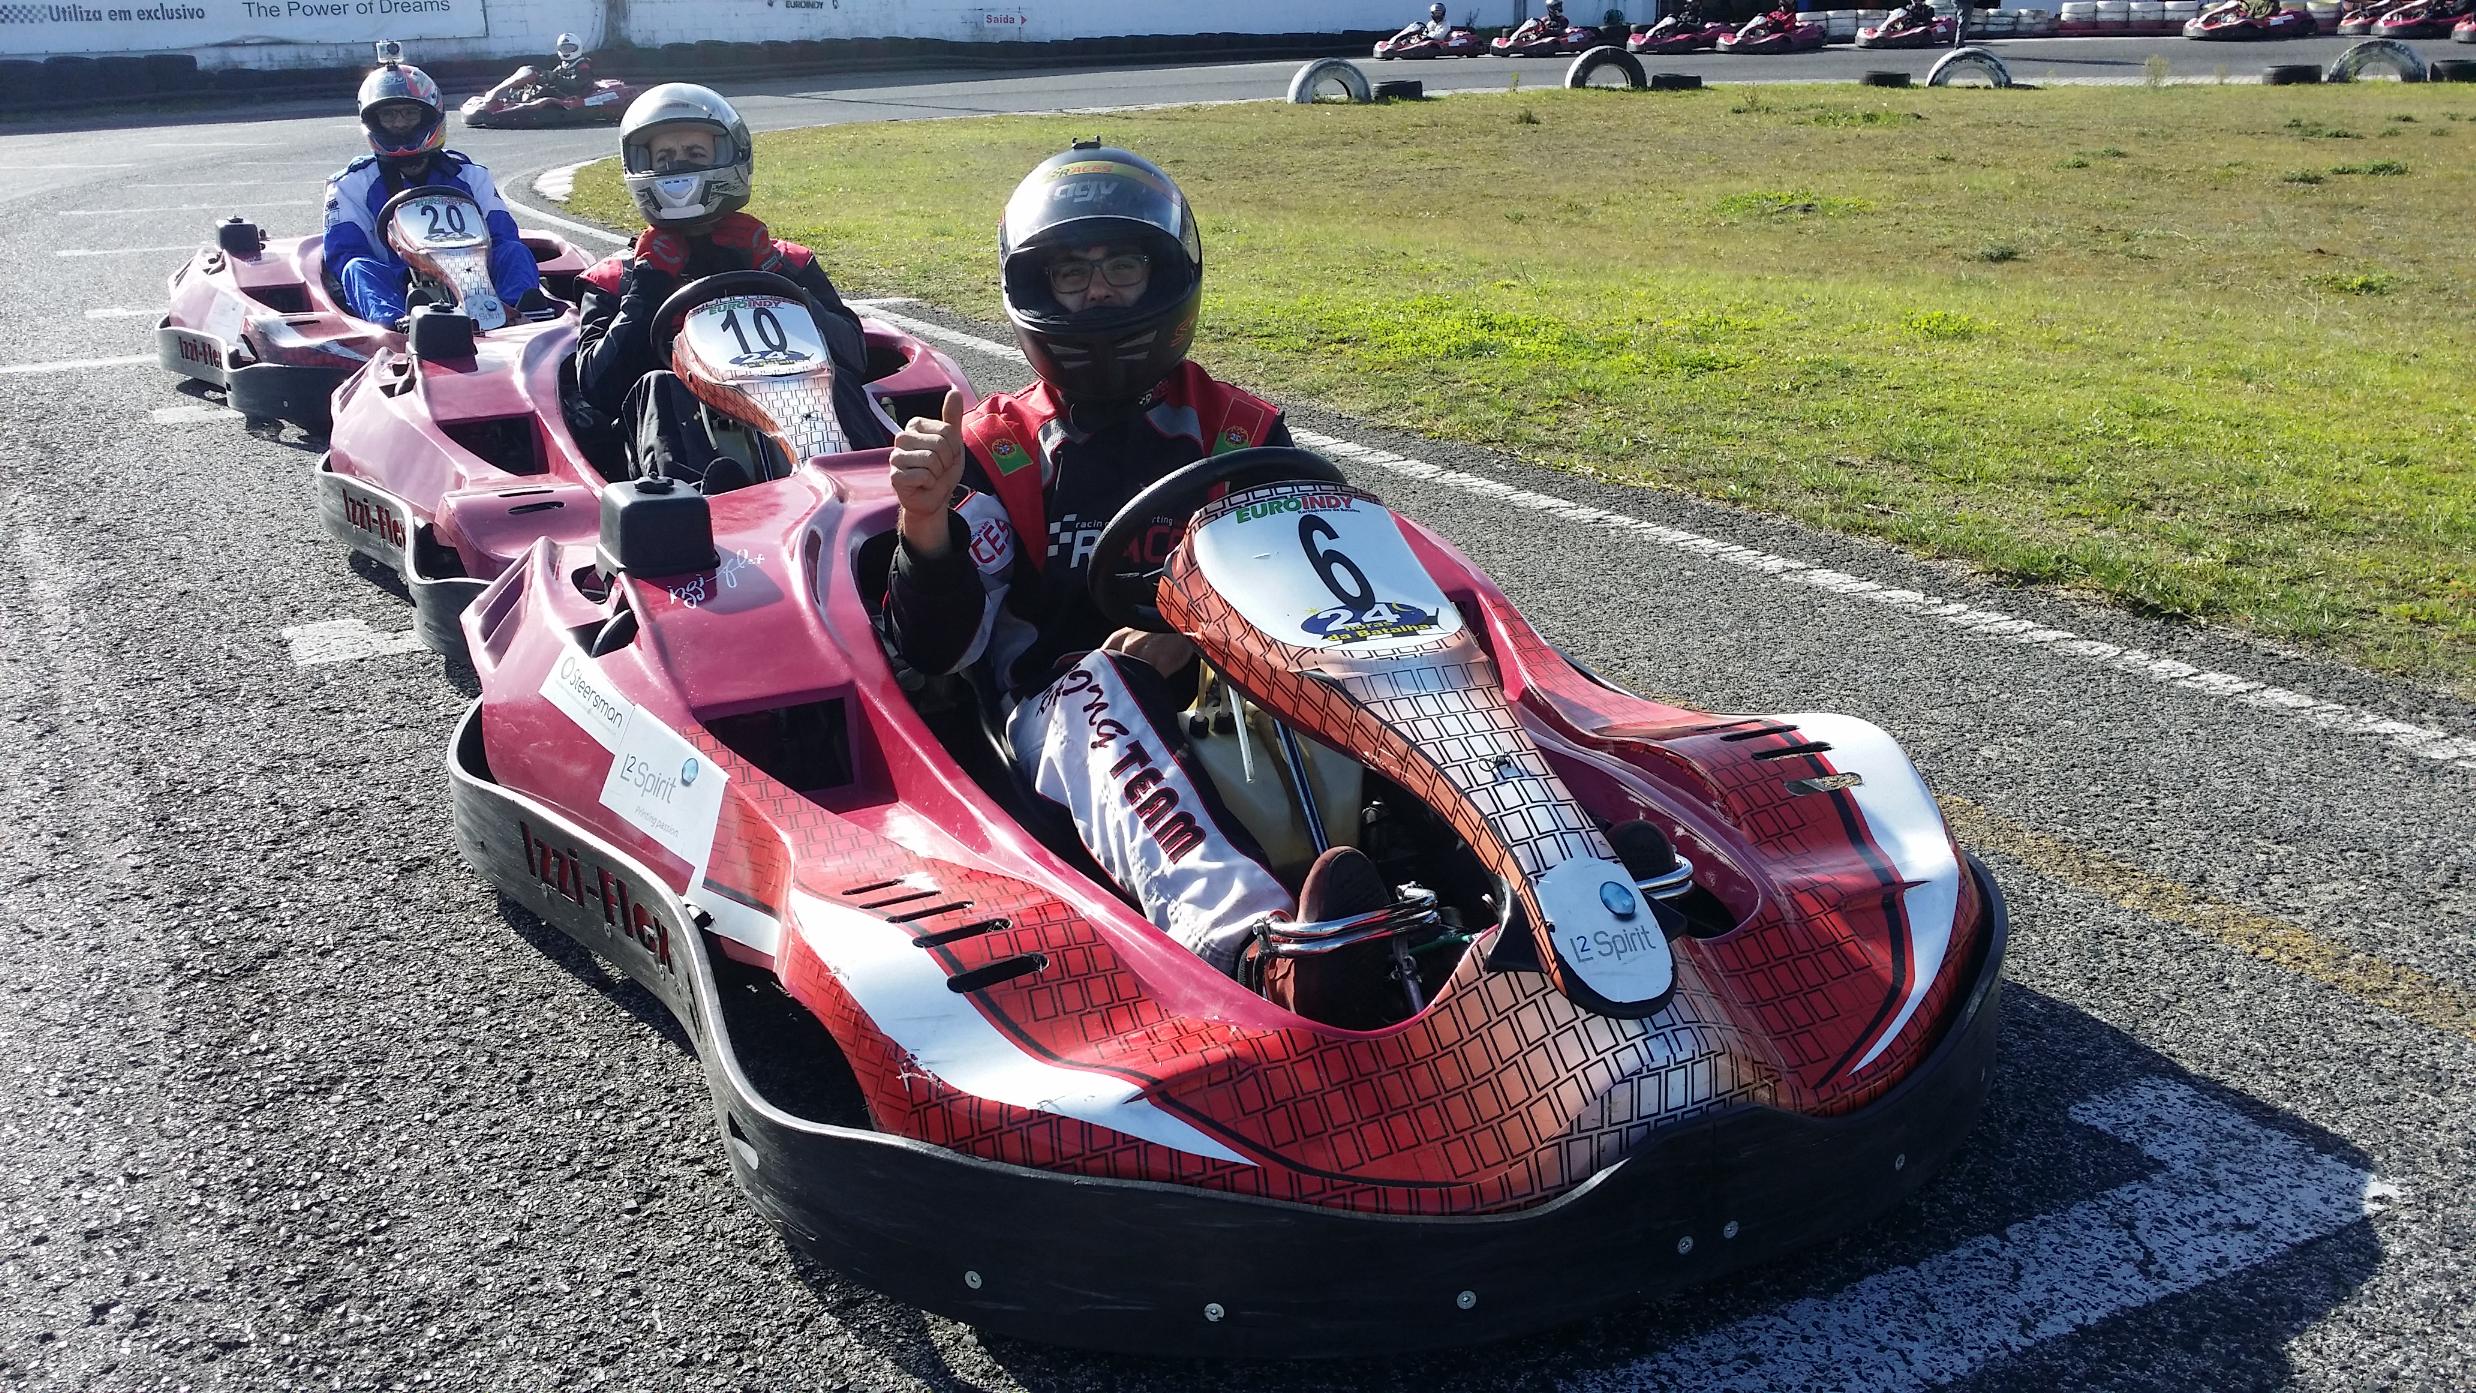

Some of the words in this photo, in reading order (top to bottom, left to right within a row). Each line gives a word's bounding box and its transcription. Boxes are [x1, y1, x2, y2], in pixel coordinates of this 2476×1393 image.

[50, 4, 102, 22] Utiliza
[108, 8, 132, 21] em
[137, 3, 205, 21] exclusivo
[242, 1, 281, 18] The
[287, 3, 350, 17] Power
[356, 1, 375, 15] of
[379, 0, 450, 14] Dreams
[1053, 180, 1119, 203] agv
[420, 205, 466, 234] 20
[709, 299, 783, 315] EUROINDY
[720, 307, 788, 354] 10
[1235, 495, 1354, 524] EUROINDY
[1297, 513, 1376, 611] 6
[1317, 603, 1401, 632] 24
[1327, 633, 1352, 641] da
[1355, 624, 1430, 637] Batalha
[634, 760, 677, 804] Spirit
[1109, 739, 1207, 865] TEAM
[1593, 925, 1657, 961] Spirit
